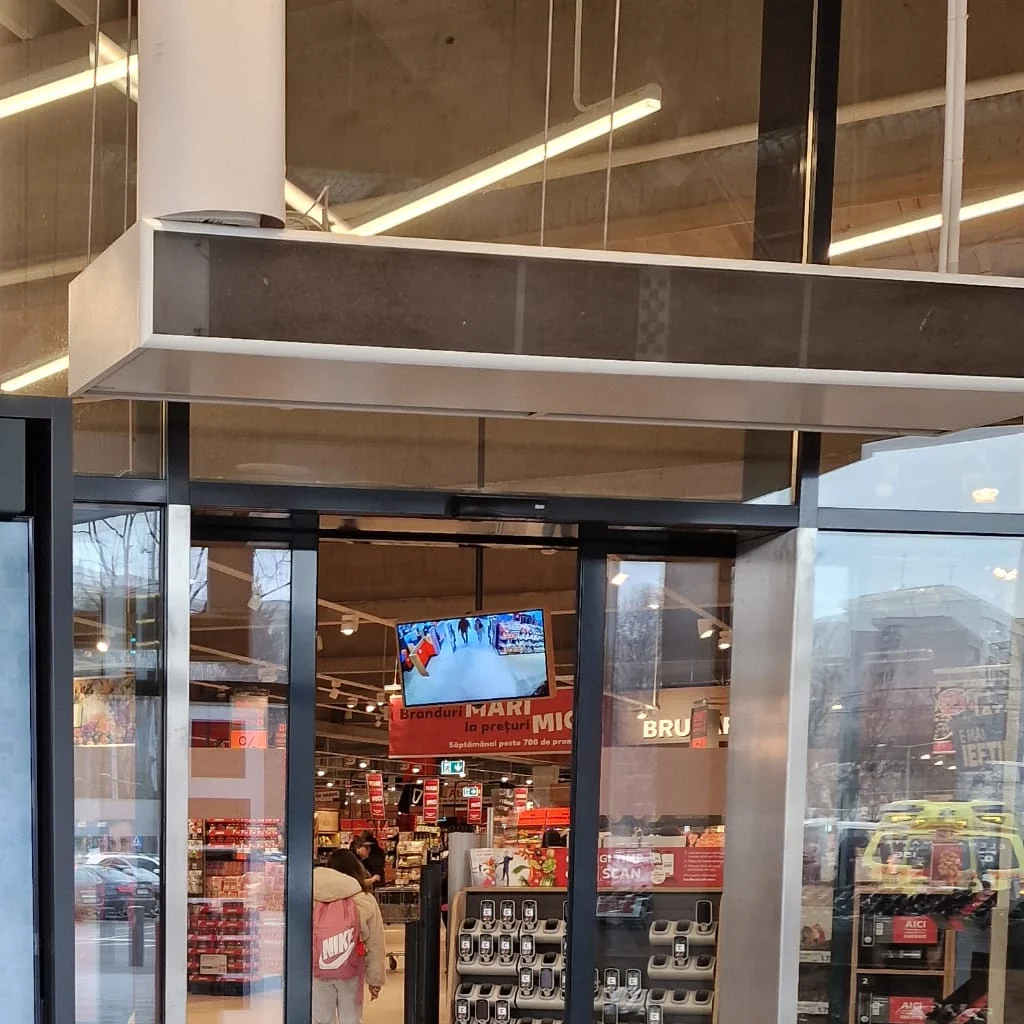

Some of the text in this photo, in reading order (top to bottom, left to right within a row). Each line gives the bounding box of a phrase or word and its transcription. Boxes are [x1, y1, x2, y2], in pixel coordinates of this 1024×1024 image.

[400, 700, 531, 720] Branduri MARI
[464, 721, 477, 732] la
[481, 720, 530, 735] prețuri
[523, 738, 538, 746] 700
[540, 738, 551, 746] de
[905, 920, 927, 929] AICI
